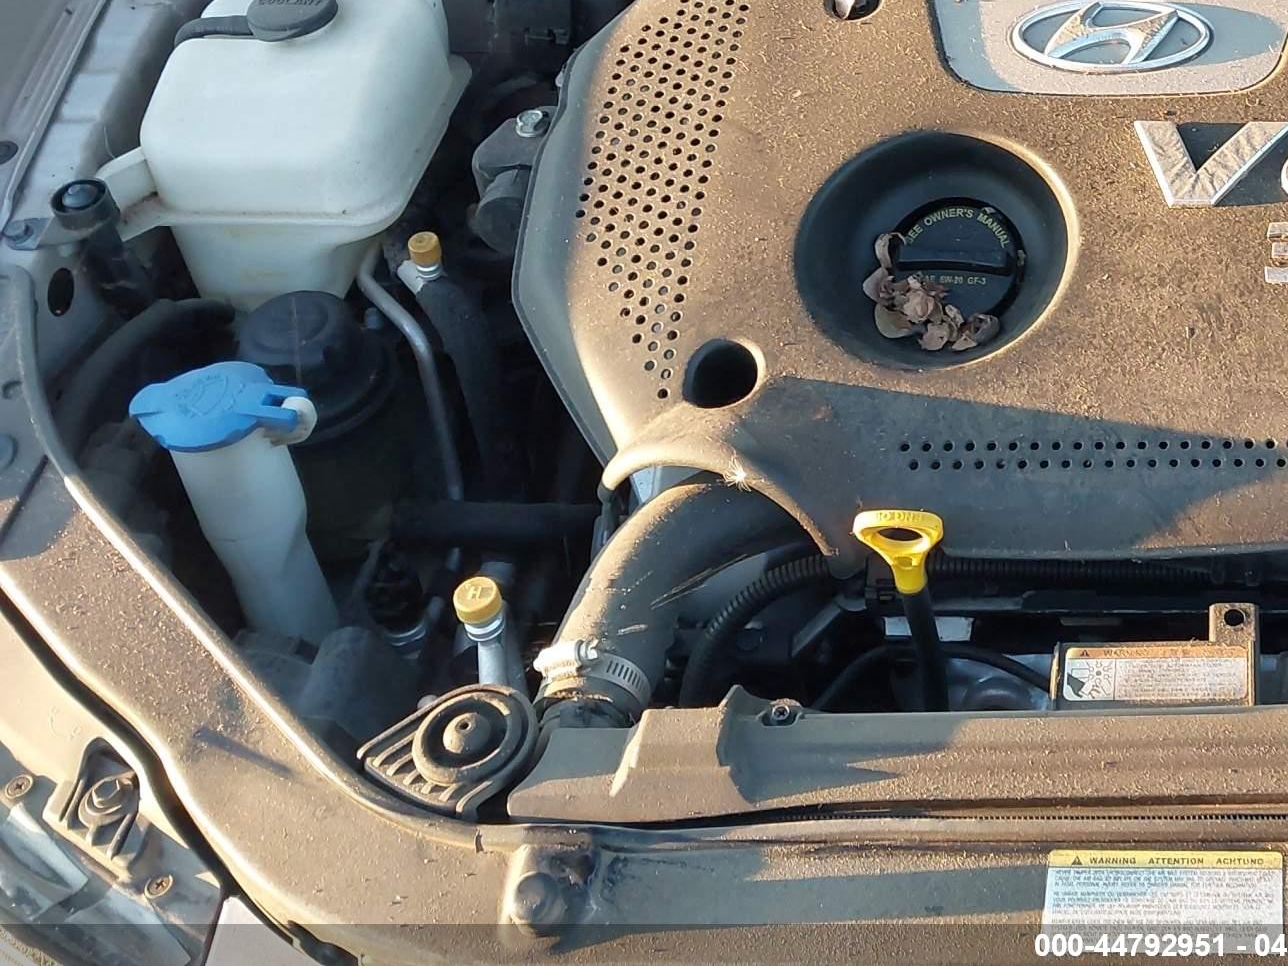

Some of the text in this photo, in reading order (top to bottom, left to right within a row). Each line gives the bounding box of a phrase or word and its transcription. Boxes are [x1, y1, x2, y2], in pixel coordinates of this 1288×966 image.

[924, 209, 973, 225] OWNER'S
[977, 214, 1010, 248] MANUAL
[1089, 857, 1136, 865] WARNING
[1147, 856, 1204, 865] ATTENTION
